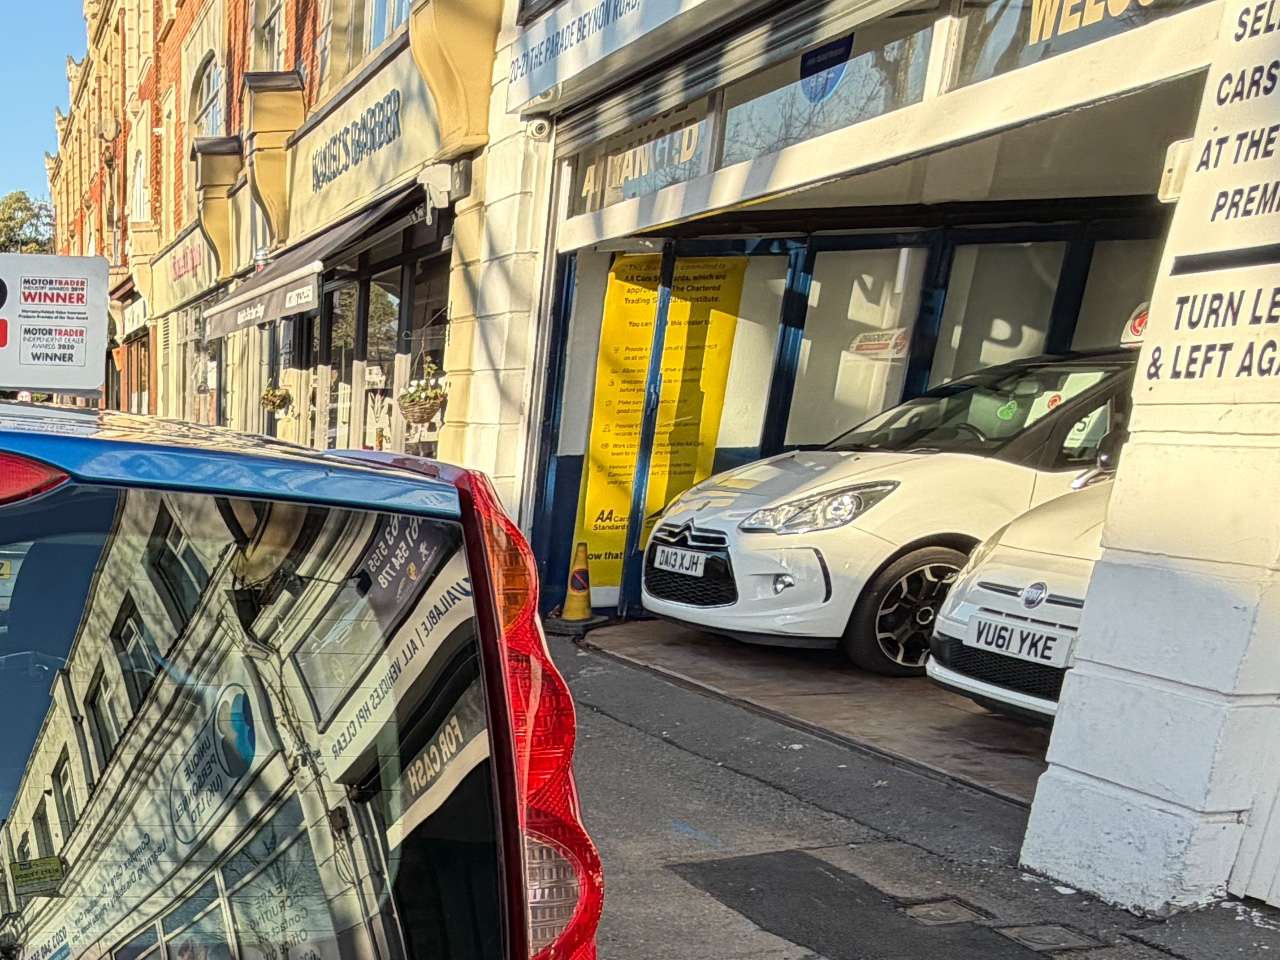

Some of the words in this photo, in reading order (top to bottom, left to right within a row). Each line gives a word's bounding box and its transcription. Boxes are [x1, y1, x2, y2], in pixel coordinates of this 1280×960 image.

[530, 40, 545, 72] THE
[545, 20, 575, 65] PARADE
[577, 0, 611, 43] BEYNON
[1234, 0, 1280, 41] SEL
[1216, 60, 1280, 106] CARS
[1195, 135, 1230, 172] AT
[1233, 124, 1280, 164] THE
[22, 291, 85, 304] WINNER
[1174, 290, 1246, 330] TURN
[31, 352, 74, 362] WINNER
[1147, 346, 1163, 380] &
[1170, 342, 1234, 380] LEFT
[1234, 339, 1280, 378] AG
[595, 508, 614, 523] AA
[604, 551, 623, 560] that
[976, 620, 1015, 651] VU61
[1018, 629, 1057, 661] YKE
